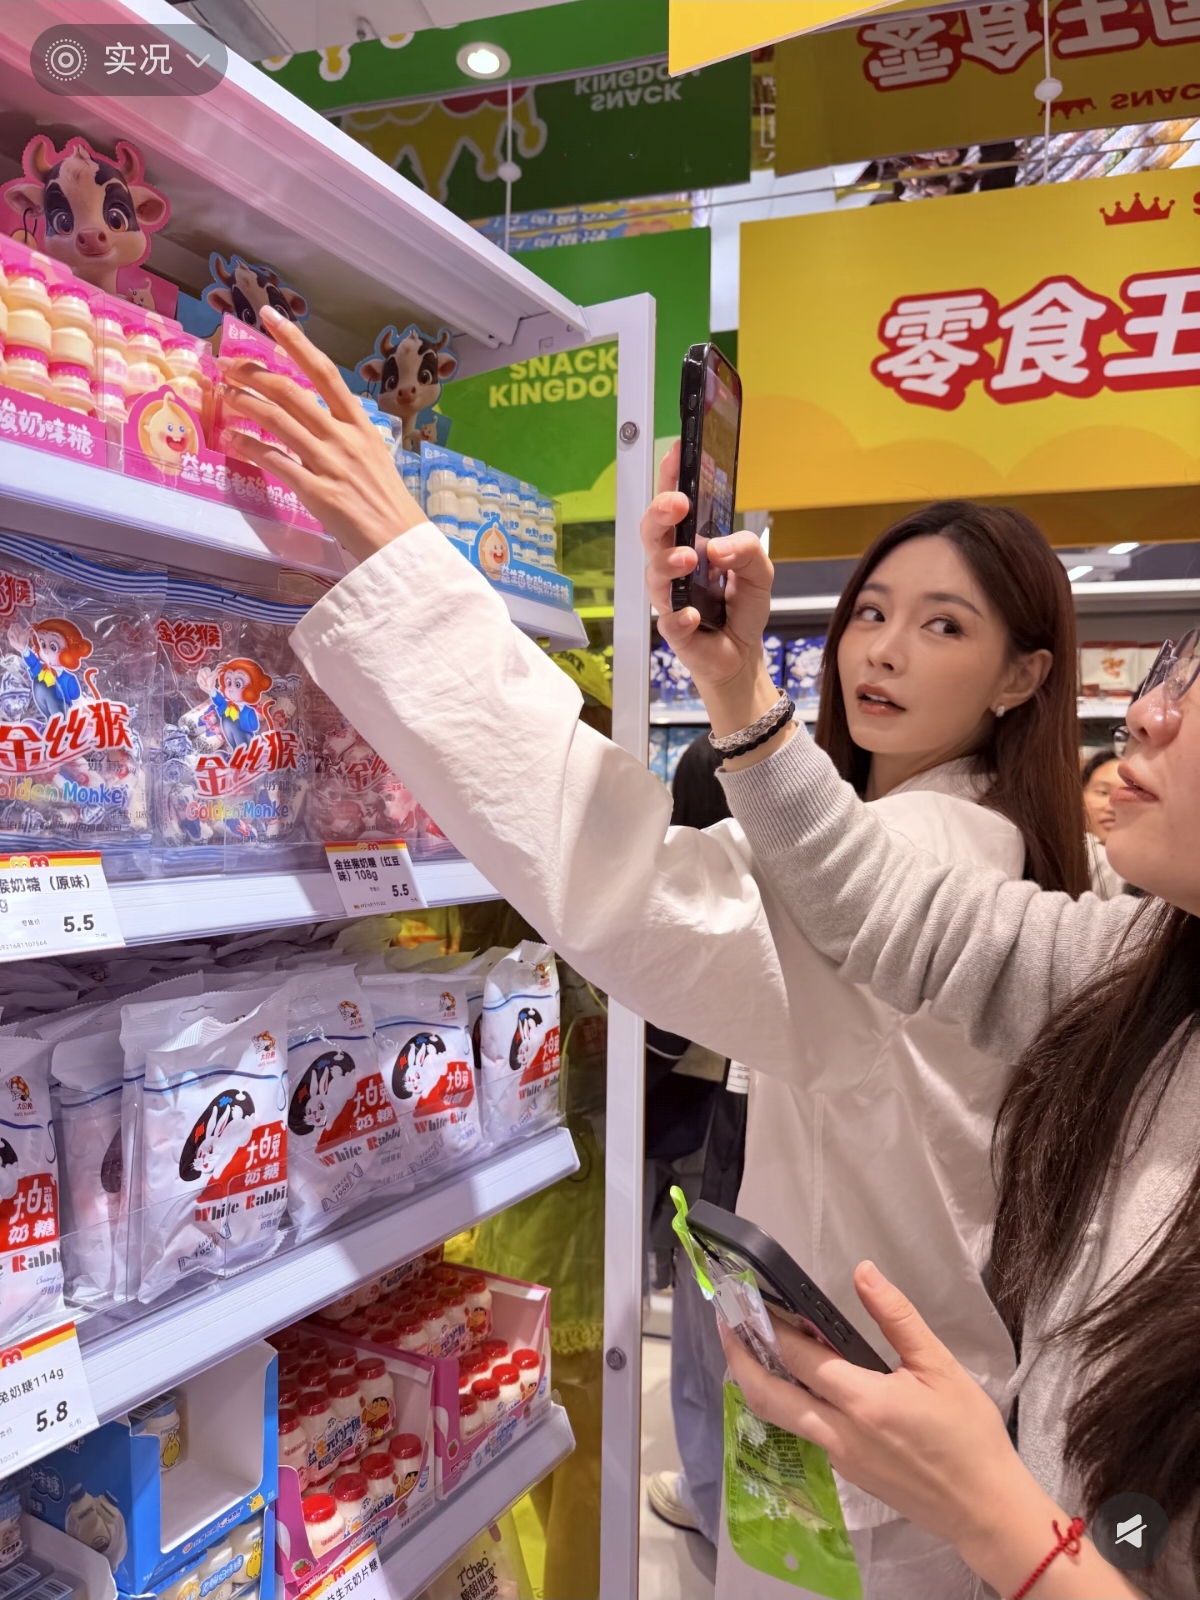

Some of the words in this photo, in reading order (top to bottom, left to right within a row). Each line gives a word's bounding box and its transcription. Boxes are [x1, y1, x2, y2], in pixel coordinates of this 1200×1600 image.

[874, 272, 1200, 399] 零食王
[509, 347, 618, 381] SNACK
[195, 730, 298, 797] 金丝猴
[186, 799, 240, 821] Golden
[391, 883, 409, 898] 5.5
[63, 914, 94, 933] 5.5
[355, 1107, 394, 1130] 奶糖
[320, 1144, 363, 1167] White
[244, 1162, 280, 1187] 奶糖
[194, 1201, 240, 1222] White
[8, 1217, 56, 1246] 奶糖
[36, 1400, 68, 1432] 5.8
